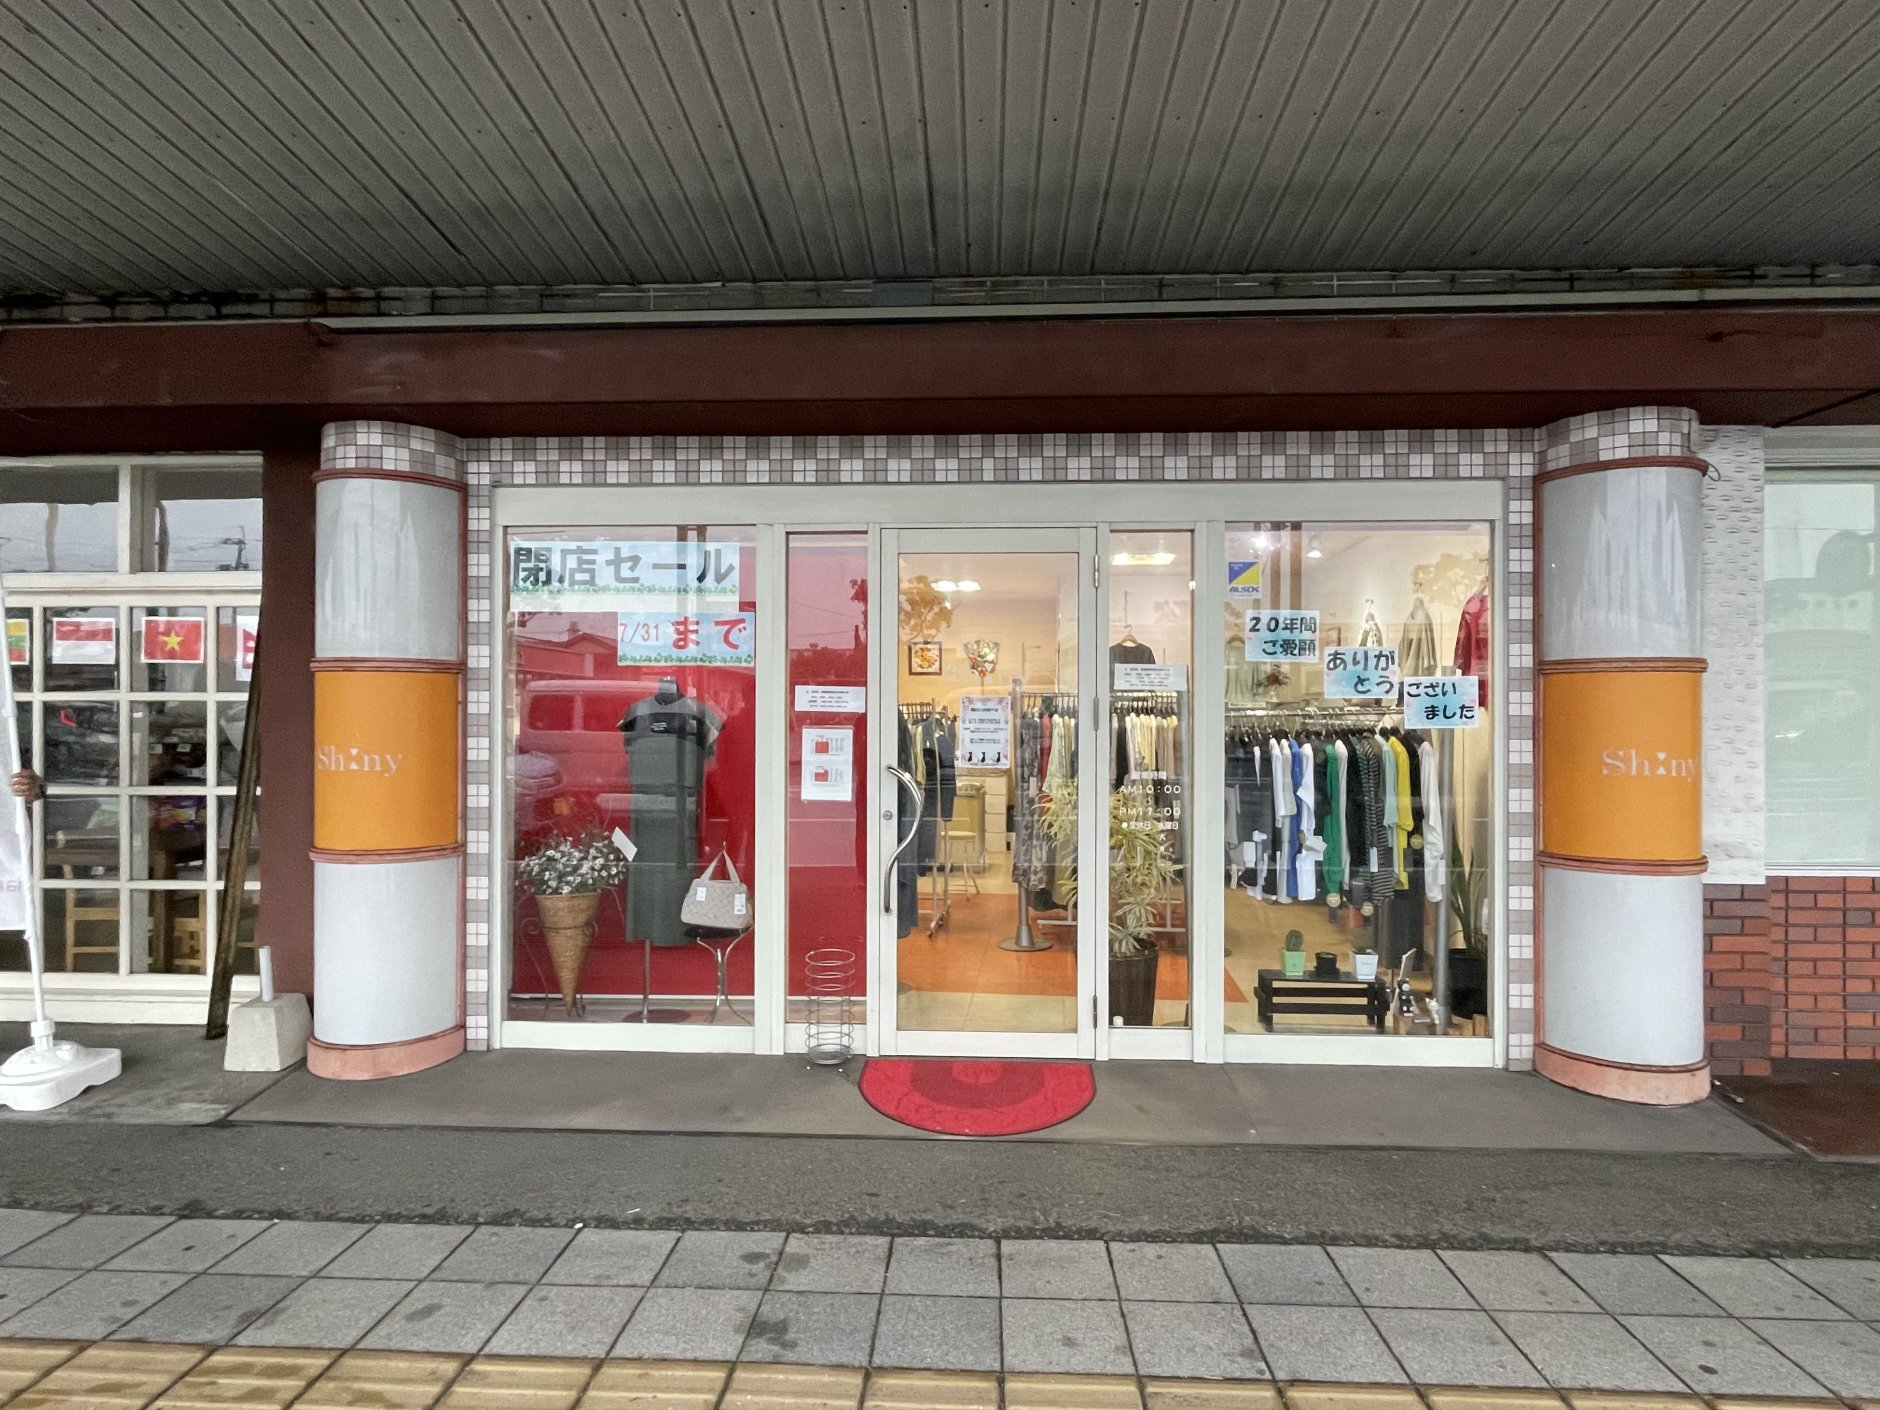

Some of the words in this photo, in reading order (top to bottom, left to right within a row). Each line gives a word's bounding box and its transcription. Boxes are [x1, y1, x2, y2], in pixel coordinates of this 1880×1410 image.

[512, 545, 737, 588] 閉店セール
[1248, 616, 1317, 634] 20年間
[1326, 650, 1396, 671] ありが
[1353, 675, 1395, 695] とう
[1406, 682, 1457, 698] ござい
[1424, 704, 1475, 720] ました
